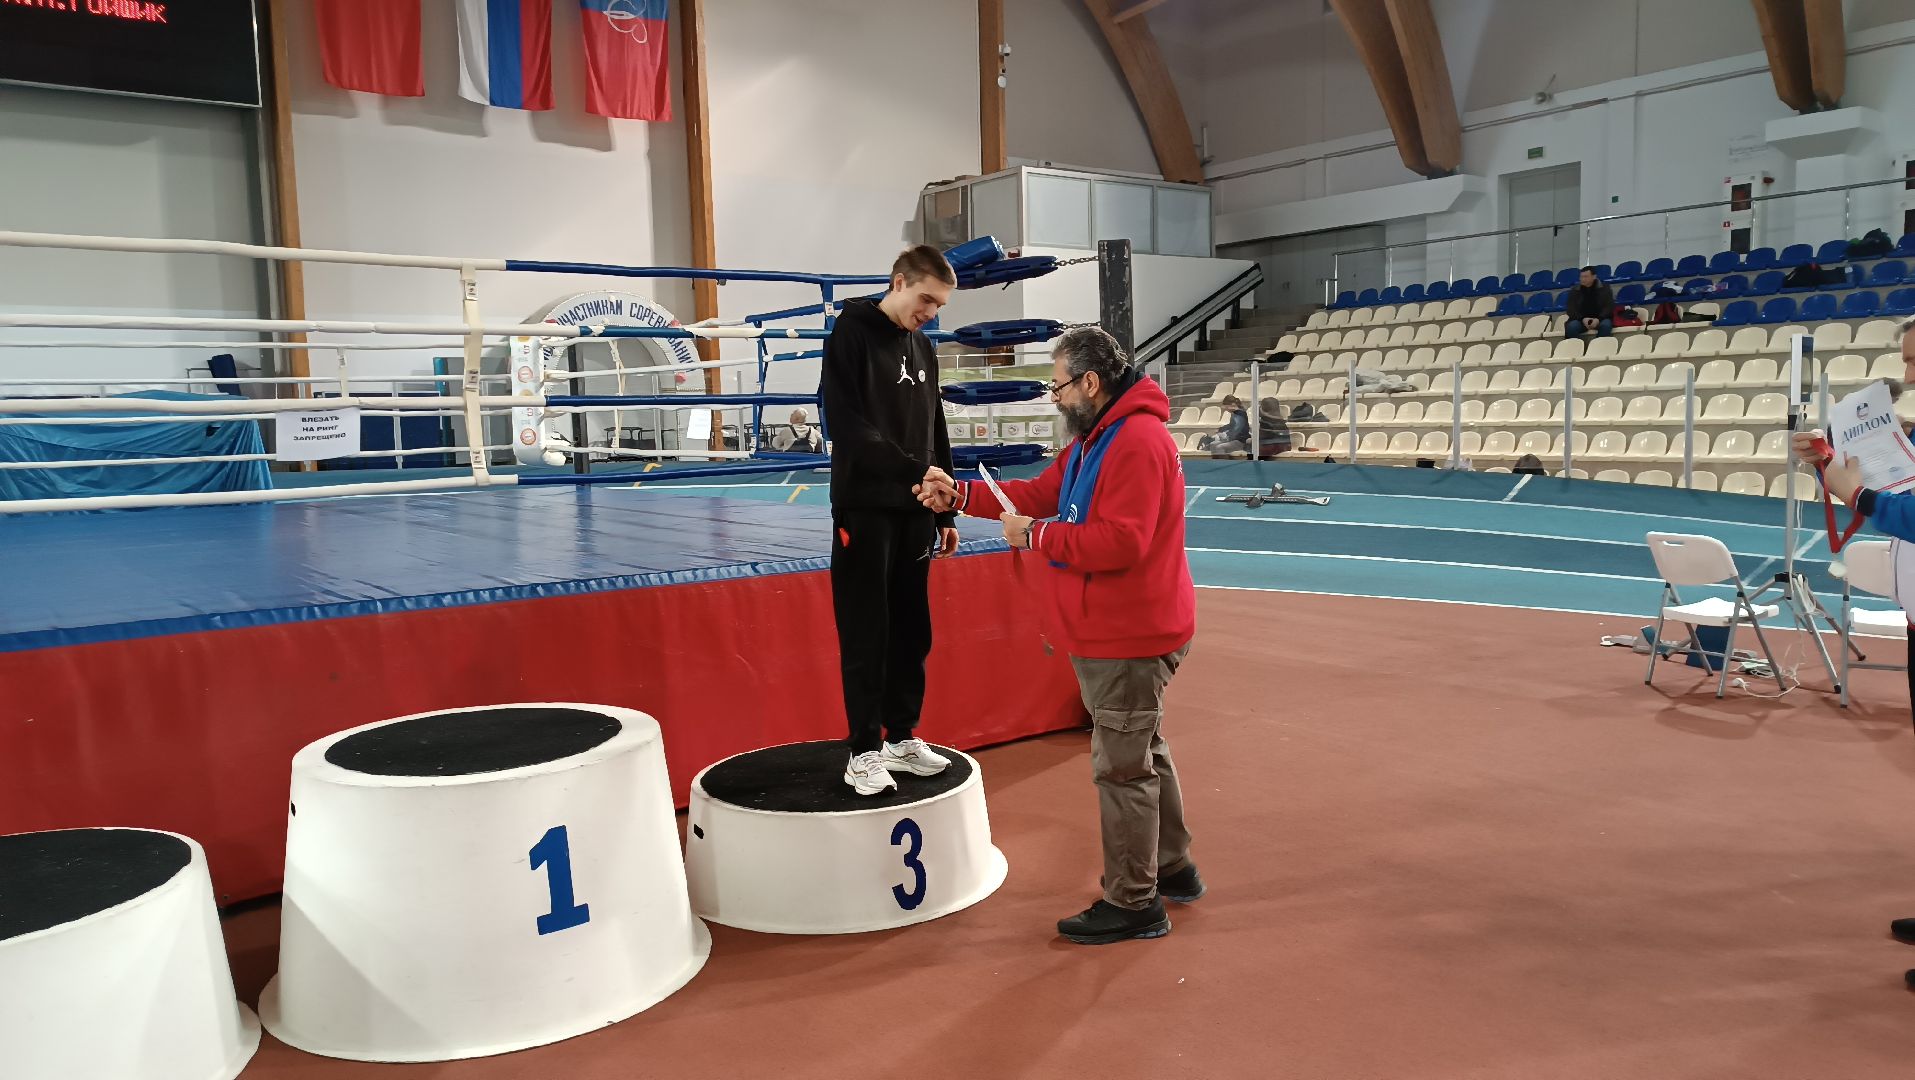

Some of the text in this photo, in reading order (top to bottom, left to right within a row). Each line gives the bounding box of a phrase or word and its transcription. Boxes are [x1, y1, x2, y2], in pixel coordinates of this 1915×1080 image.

[301, 415, 340, 423] ВЛЕЗАТЬ
[316, 424, 339, 432] РИНГ
[1841, 412, 1892, 445] ДИПЛОМ
[293, 432, 346, 441] ЗАПРЕЩЕНО
[890, 817, 927, 910] 3
[528, 824, 590, 936] 1
